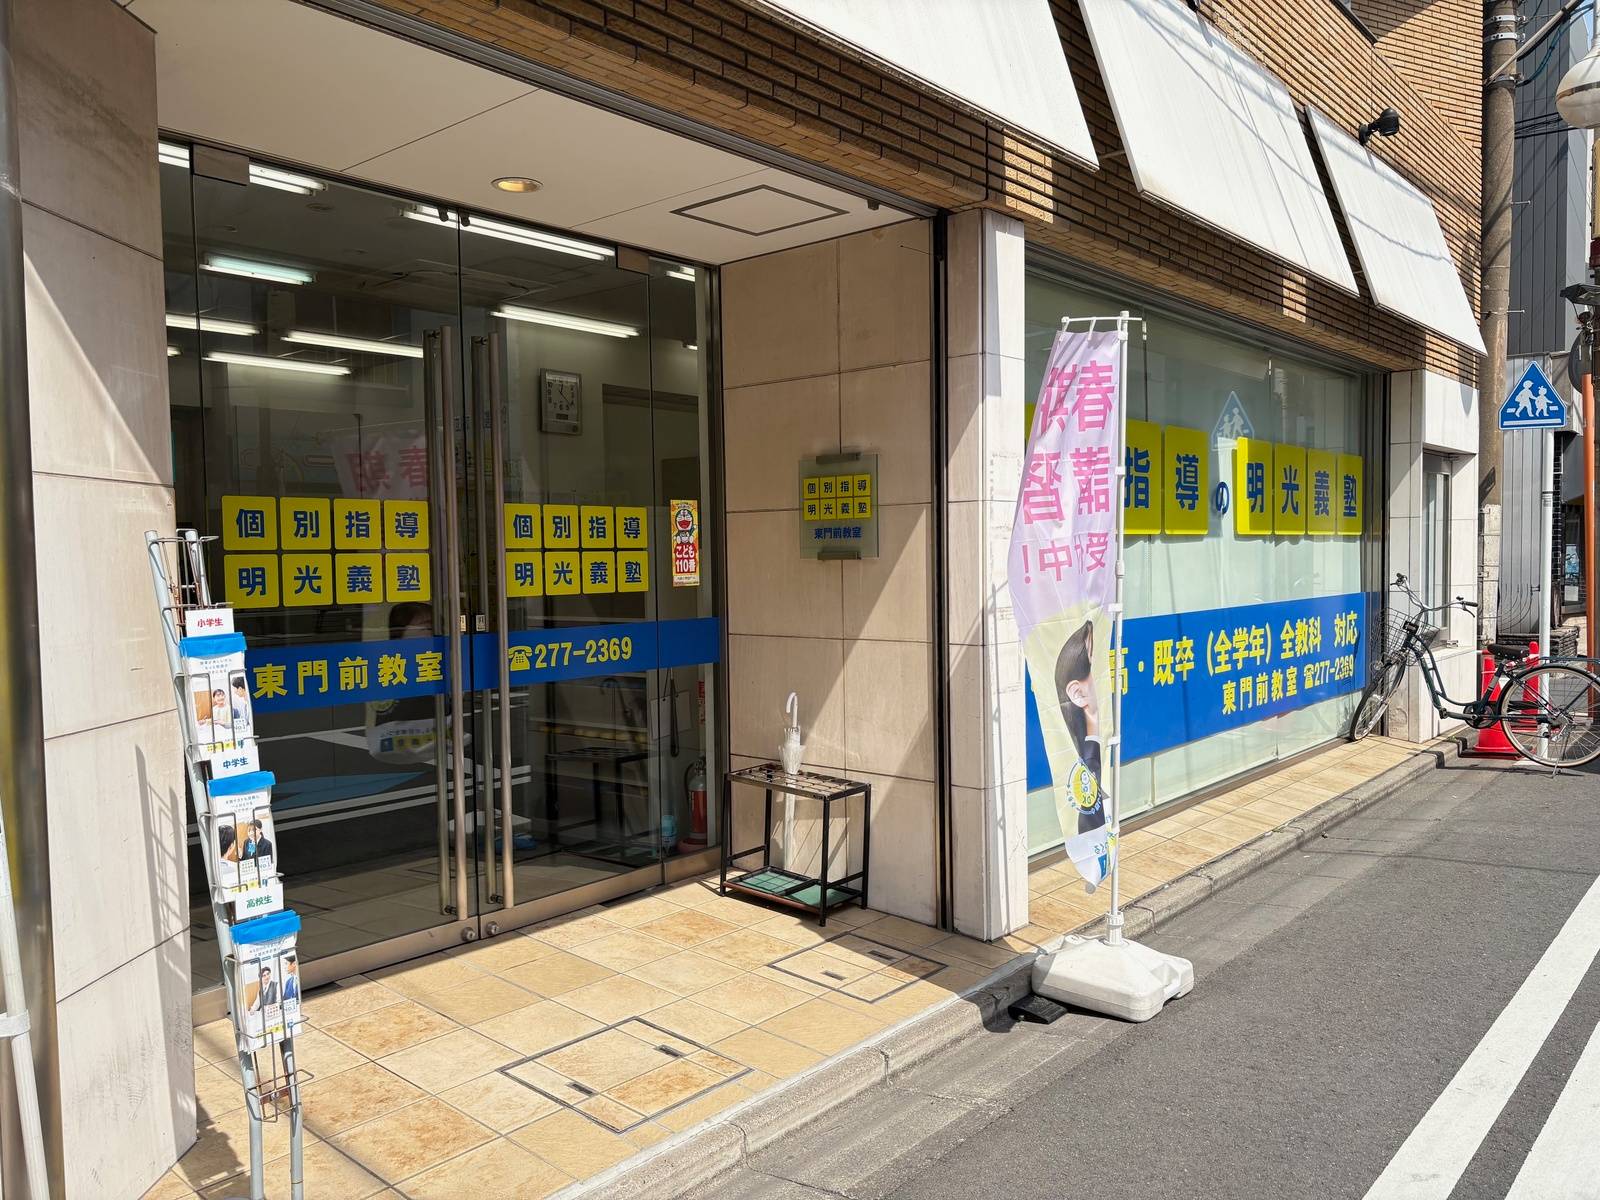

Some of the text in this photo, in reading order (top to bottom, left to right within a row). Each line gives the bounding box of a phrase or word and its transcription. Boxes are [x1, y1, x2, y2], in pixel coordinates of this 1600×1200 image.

[807, 480, 867, 494] 個別指導
[807, 502, 867, 516] 明光義塾
[235, 508, 420, 539] 個別指導
[513, 514, 641, 539] 個別指導
[814, 526, 862, 540] 東門前教室
[676, 545, 695, 558] こども
[514, 561, 642, 587] 明光義塾
[676, 559, 696, 572] 110番
[238, 565, 421, 597] 明光義塾
[197, 618, 224, 628] 小学生
[1334, 610, 1358, 648] 対応
[534, 636, 633, 669] 277-2369
[252, 651, 443, 699] 東門前教室
[1314, 654, 1354, 686] 277-2369
[1222, 665, 1298, 715] 東門前教室
[223, 757, 249, 769] 中学生
[246, 895, 273, 909] 高校生
